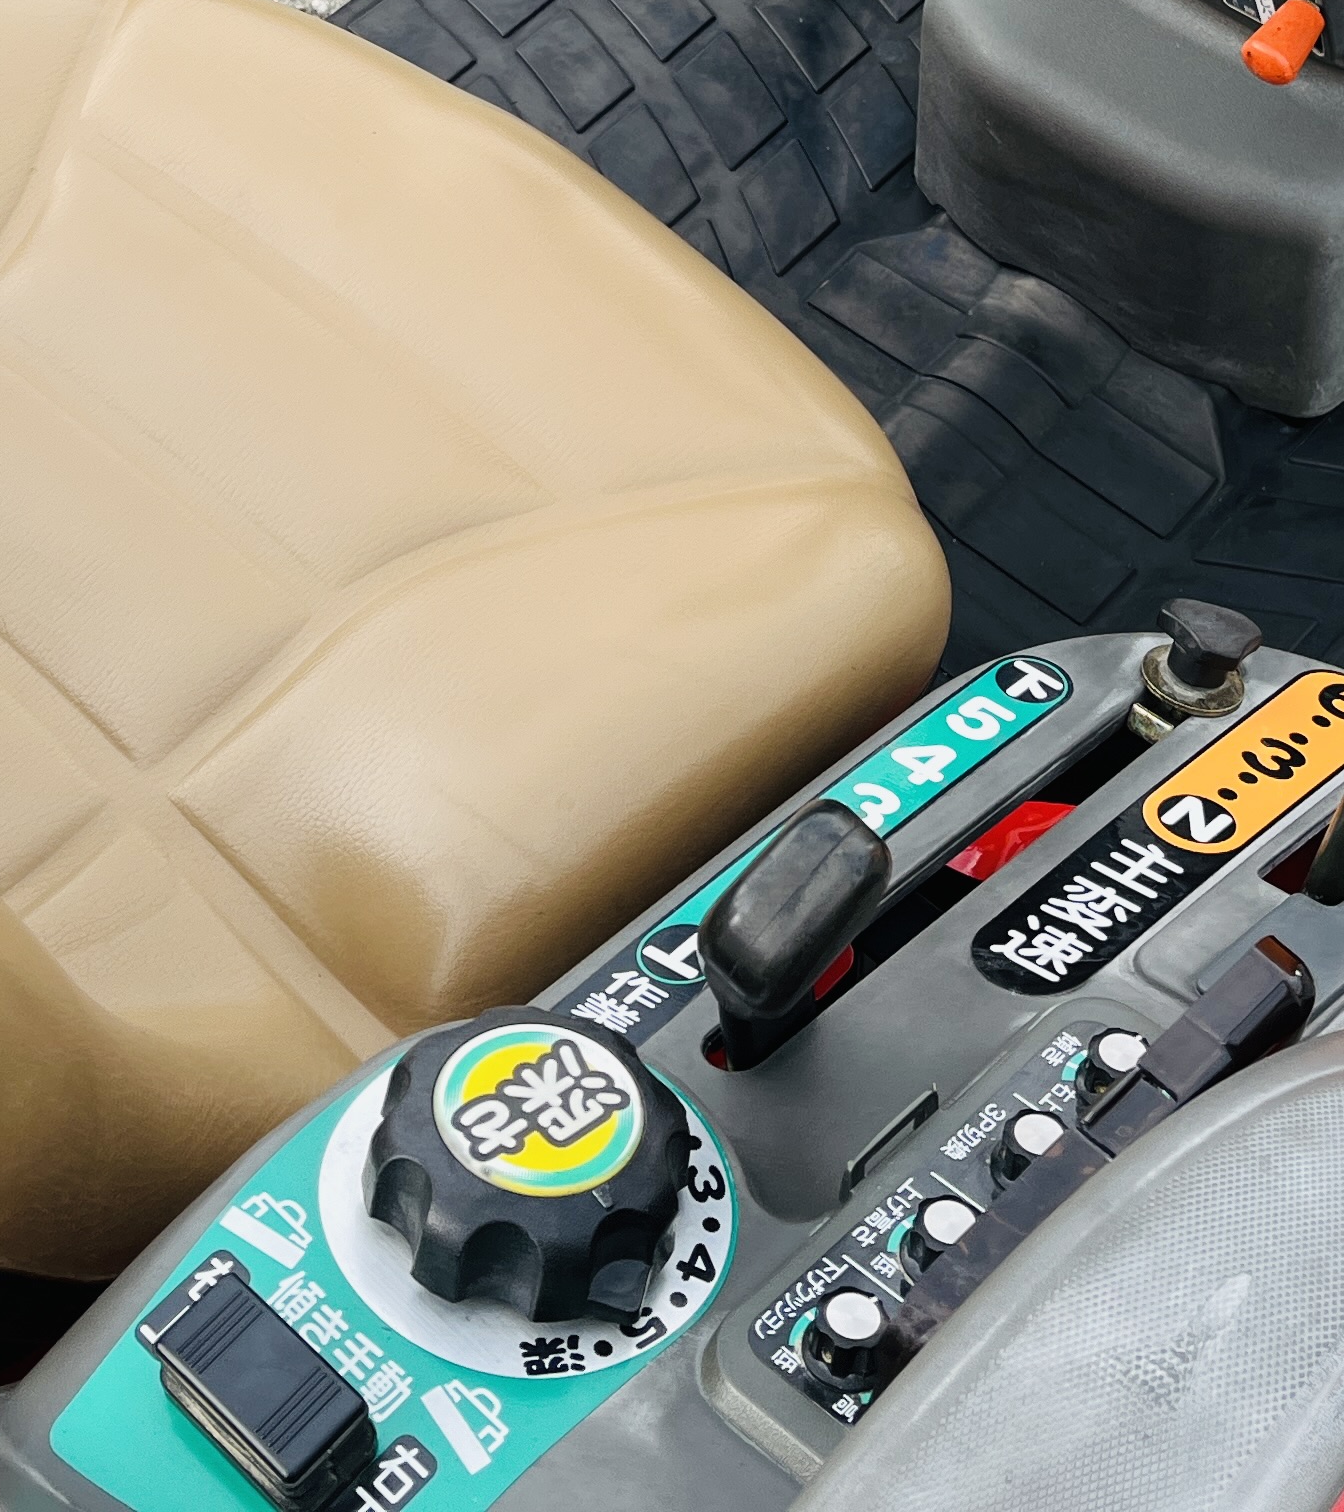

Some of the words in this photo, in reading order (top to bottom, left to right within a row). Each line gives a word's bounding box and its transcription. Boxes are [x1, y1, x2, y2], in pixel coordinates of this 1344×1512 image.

[1007, 660, 1064, 701] 下
[946, 695, 1017, 741] 5
[890, 744, 958, 786] 4
[1241, 737, 1307, 781] 3
[853, 782, 902, 831] 3
[1160, 795, 1233, 843] N
[989, 837, 1185, 984] 主変速
[1041, 1031, 1083, 1067] 傾き
[452, 1039, 630, 1159] 深さ
[939, 1102, 1007, 1161] 3P切換
[687, 1162, 727, 1204] 3
[851, 1177, 923, 1248] 上げ高さ
[676, 1242, 716, 1286] 4
[754, 1256, 849, 1340] 下げクッション
[265, 1269, 414, 1423] 傾き手動
[621, 1307, 668, 1352] 5
[519, 1334, 586, 1377] 深
